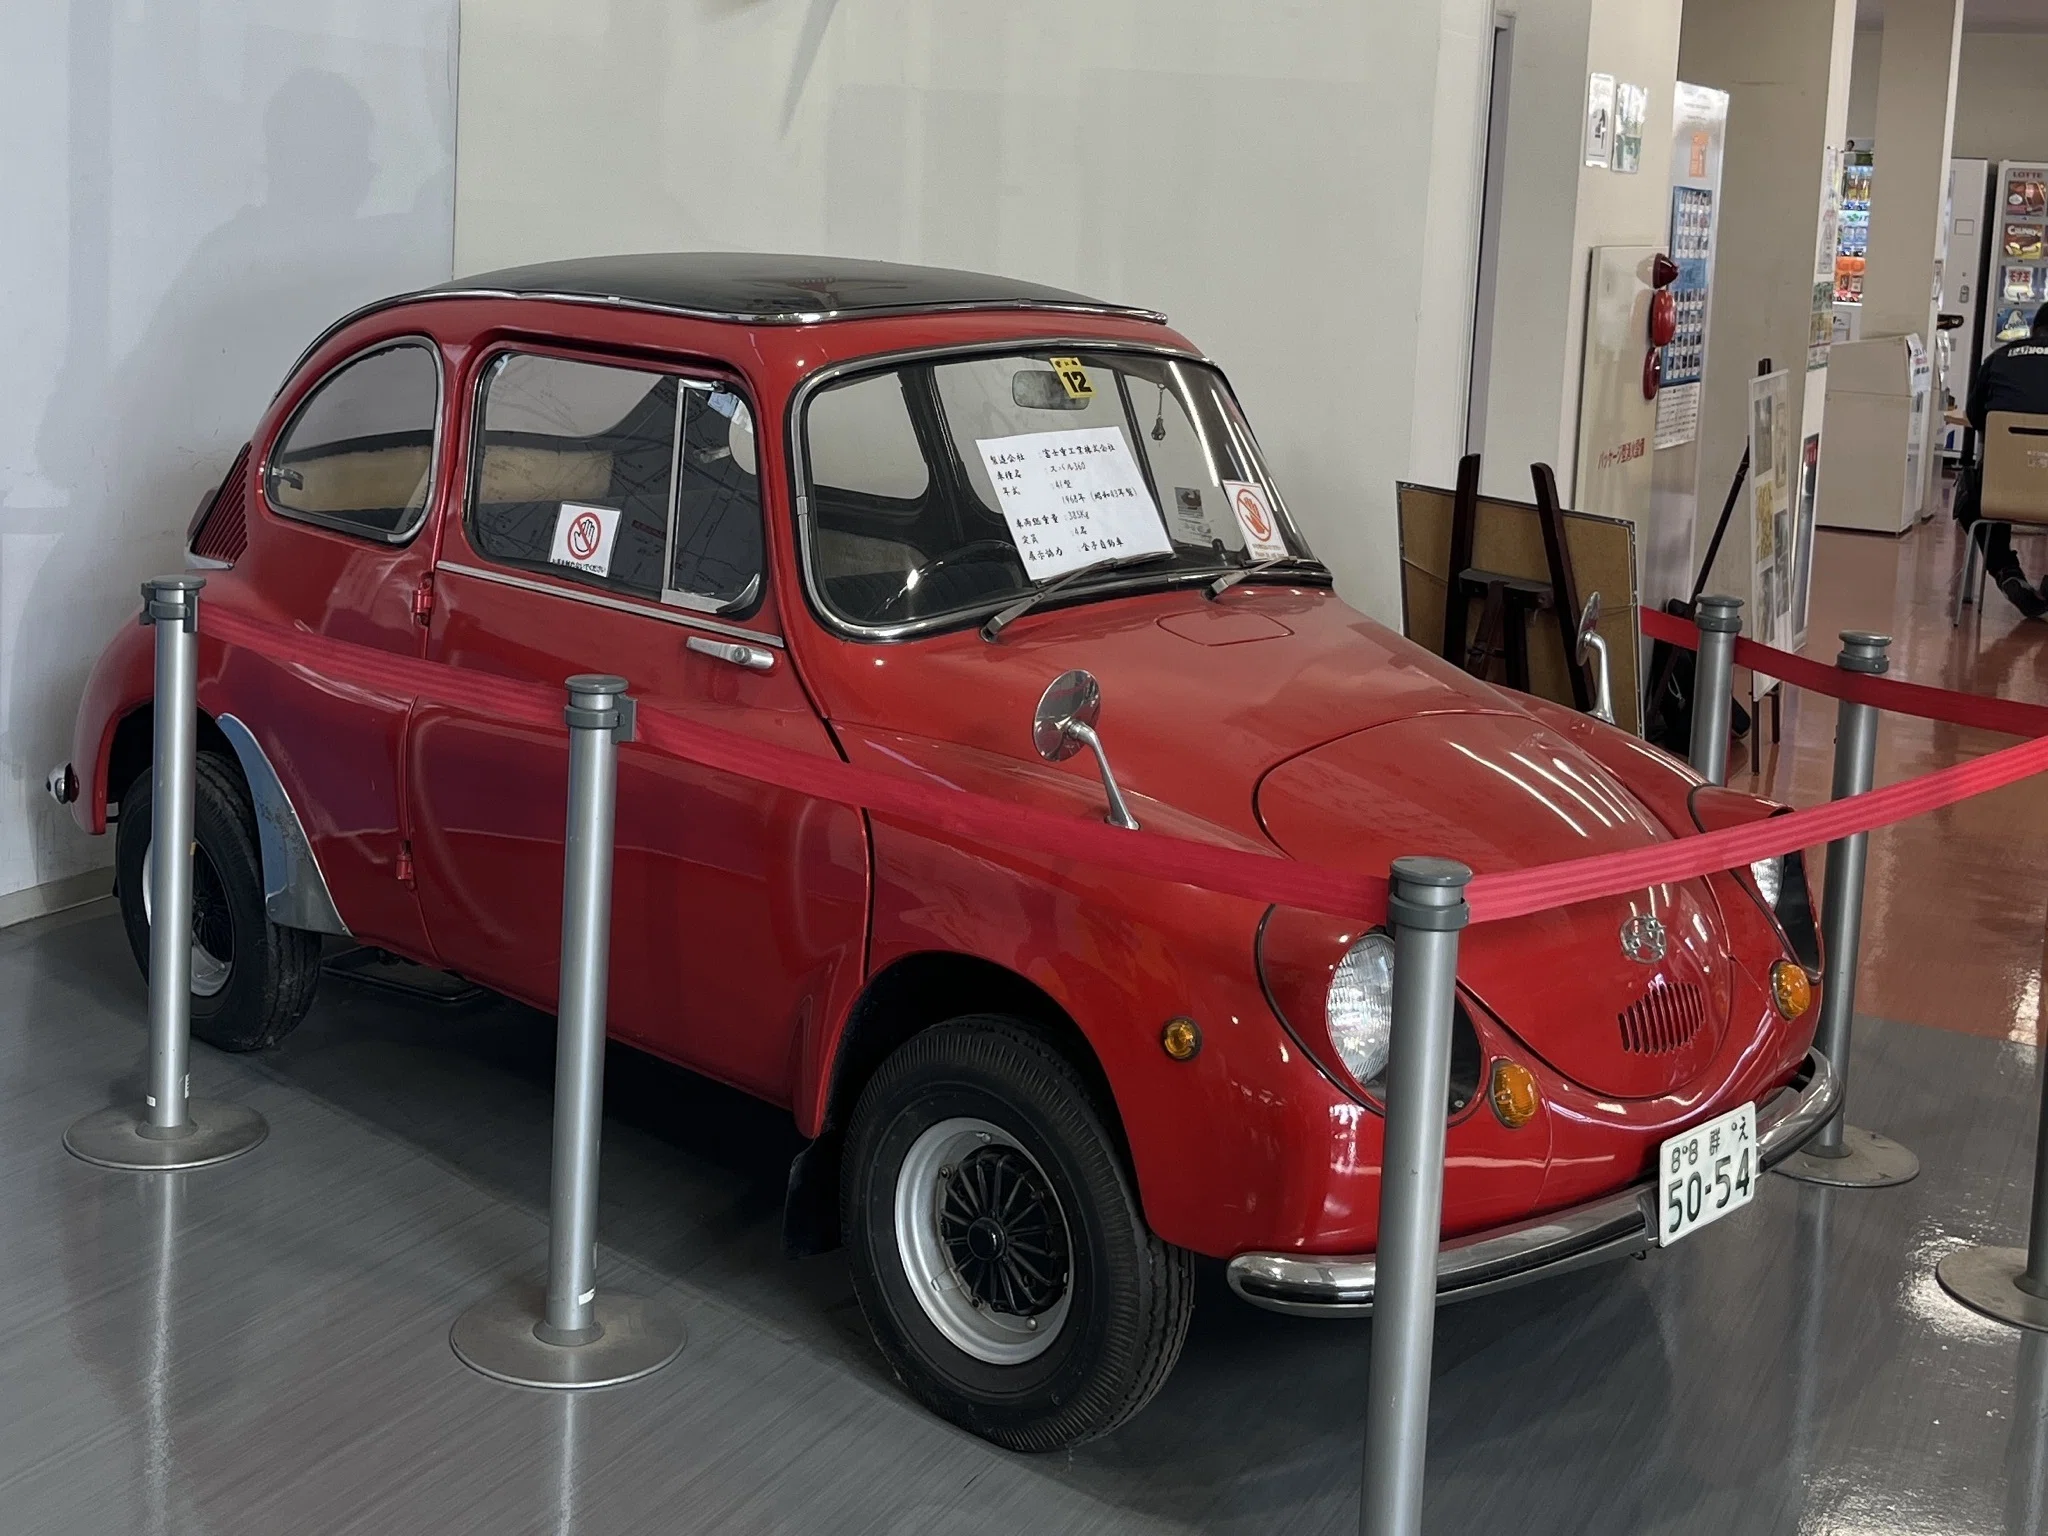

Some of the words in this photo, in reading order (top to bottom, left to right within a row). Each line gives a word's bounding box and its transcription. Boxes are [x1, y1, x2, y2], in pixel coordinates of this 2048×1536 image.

[2013, 171, 2043, 179] LOTTE
[1062, 371, 1092, 393] 12
[989, 452, 1025, 466] 製造会社
[1002, 486, 1021, 497] 年式
[1709, 1126, 1721, 1157] 群
[1738, 1115, 1749, 1143] え
[1668, 1147, 1750, 1233] 50-54
